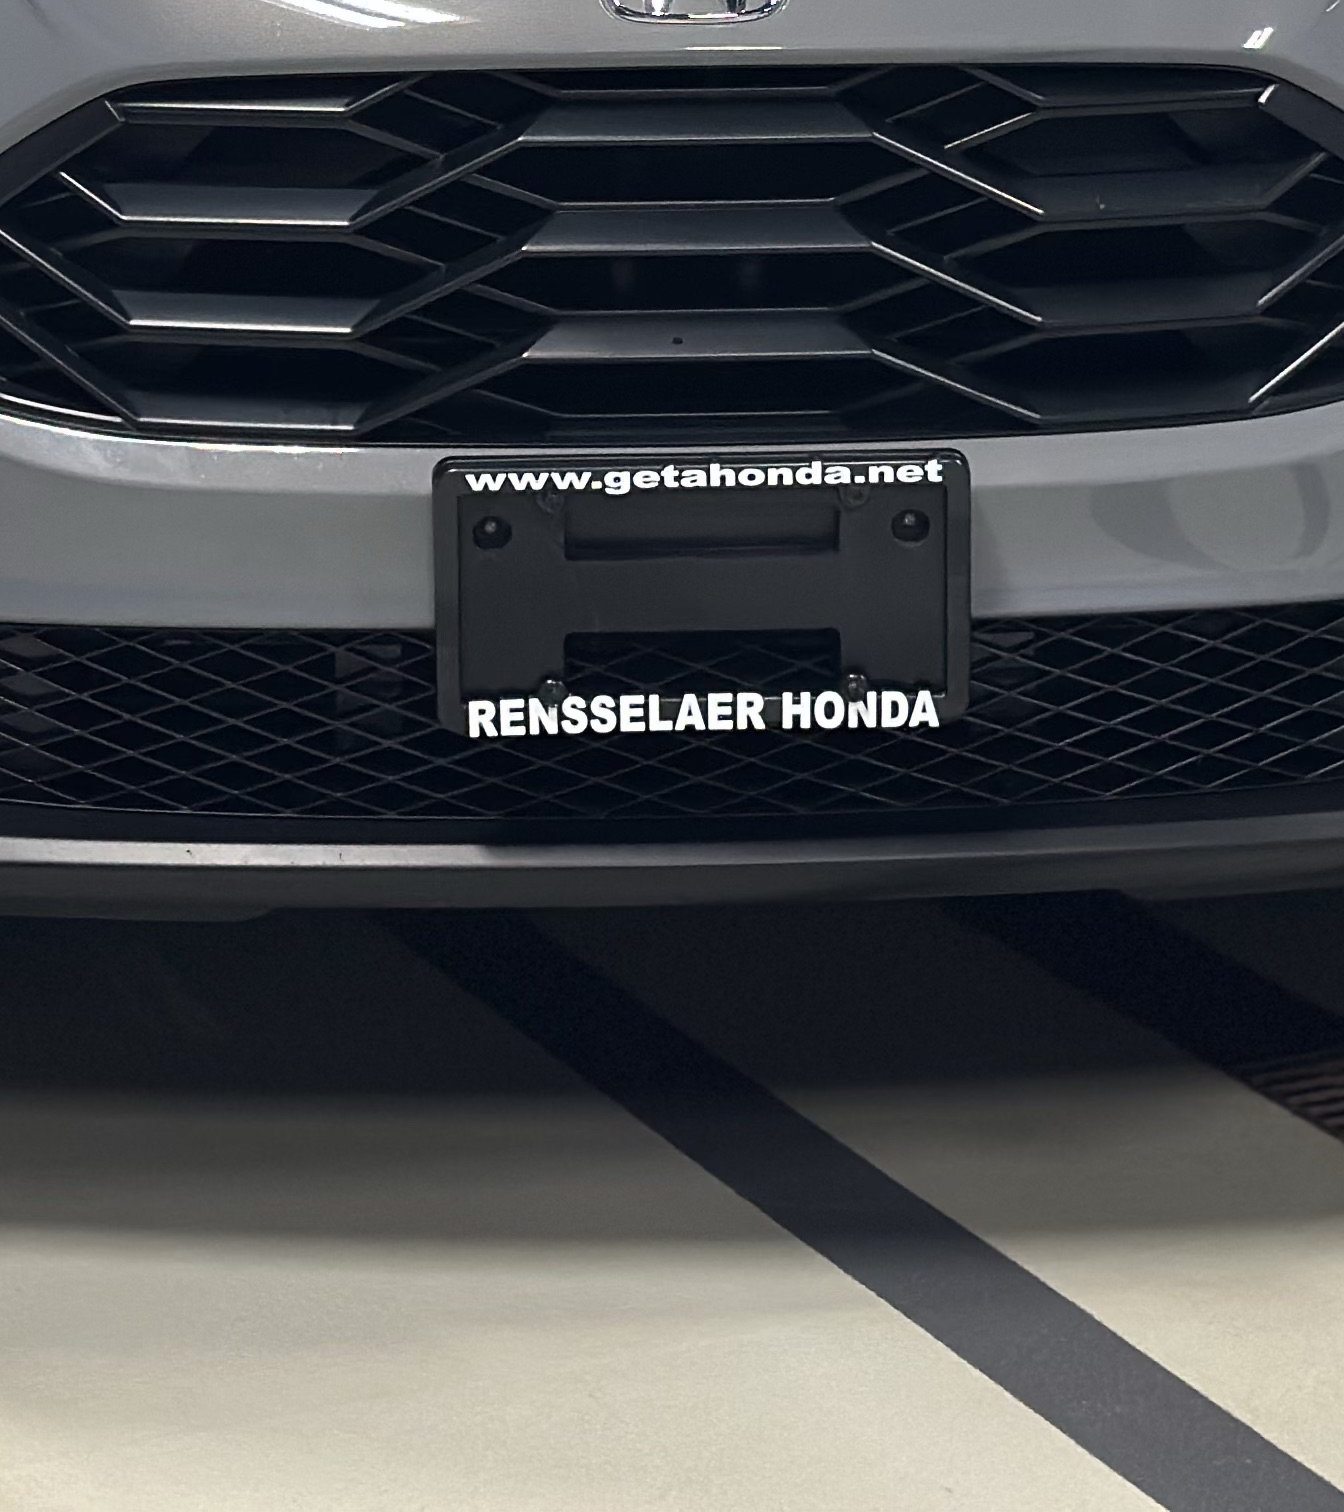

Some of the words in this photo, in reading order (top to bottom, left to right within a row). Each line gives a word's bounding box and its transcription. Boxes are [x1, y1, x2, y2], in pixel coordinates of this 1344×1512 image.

[465, 459, 943, 495] www.getahonda.net
[467, 693, 766, 738] RENSSELAER
[781, 690, 940, 730] HONDA
